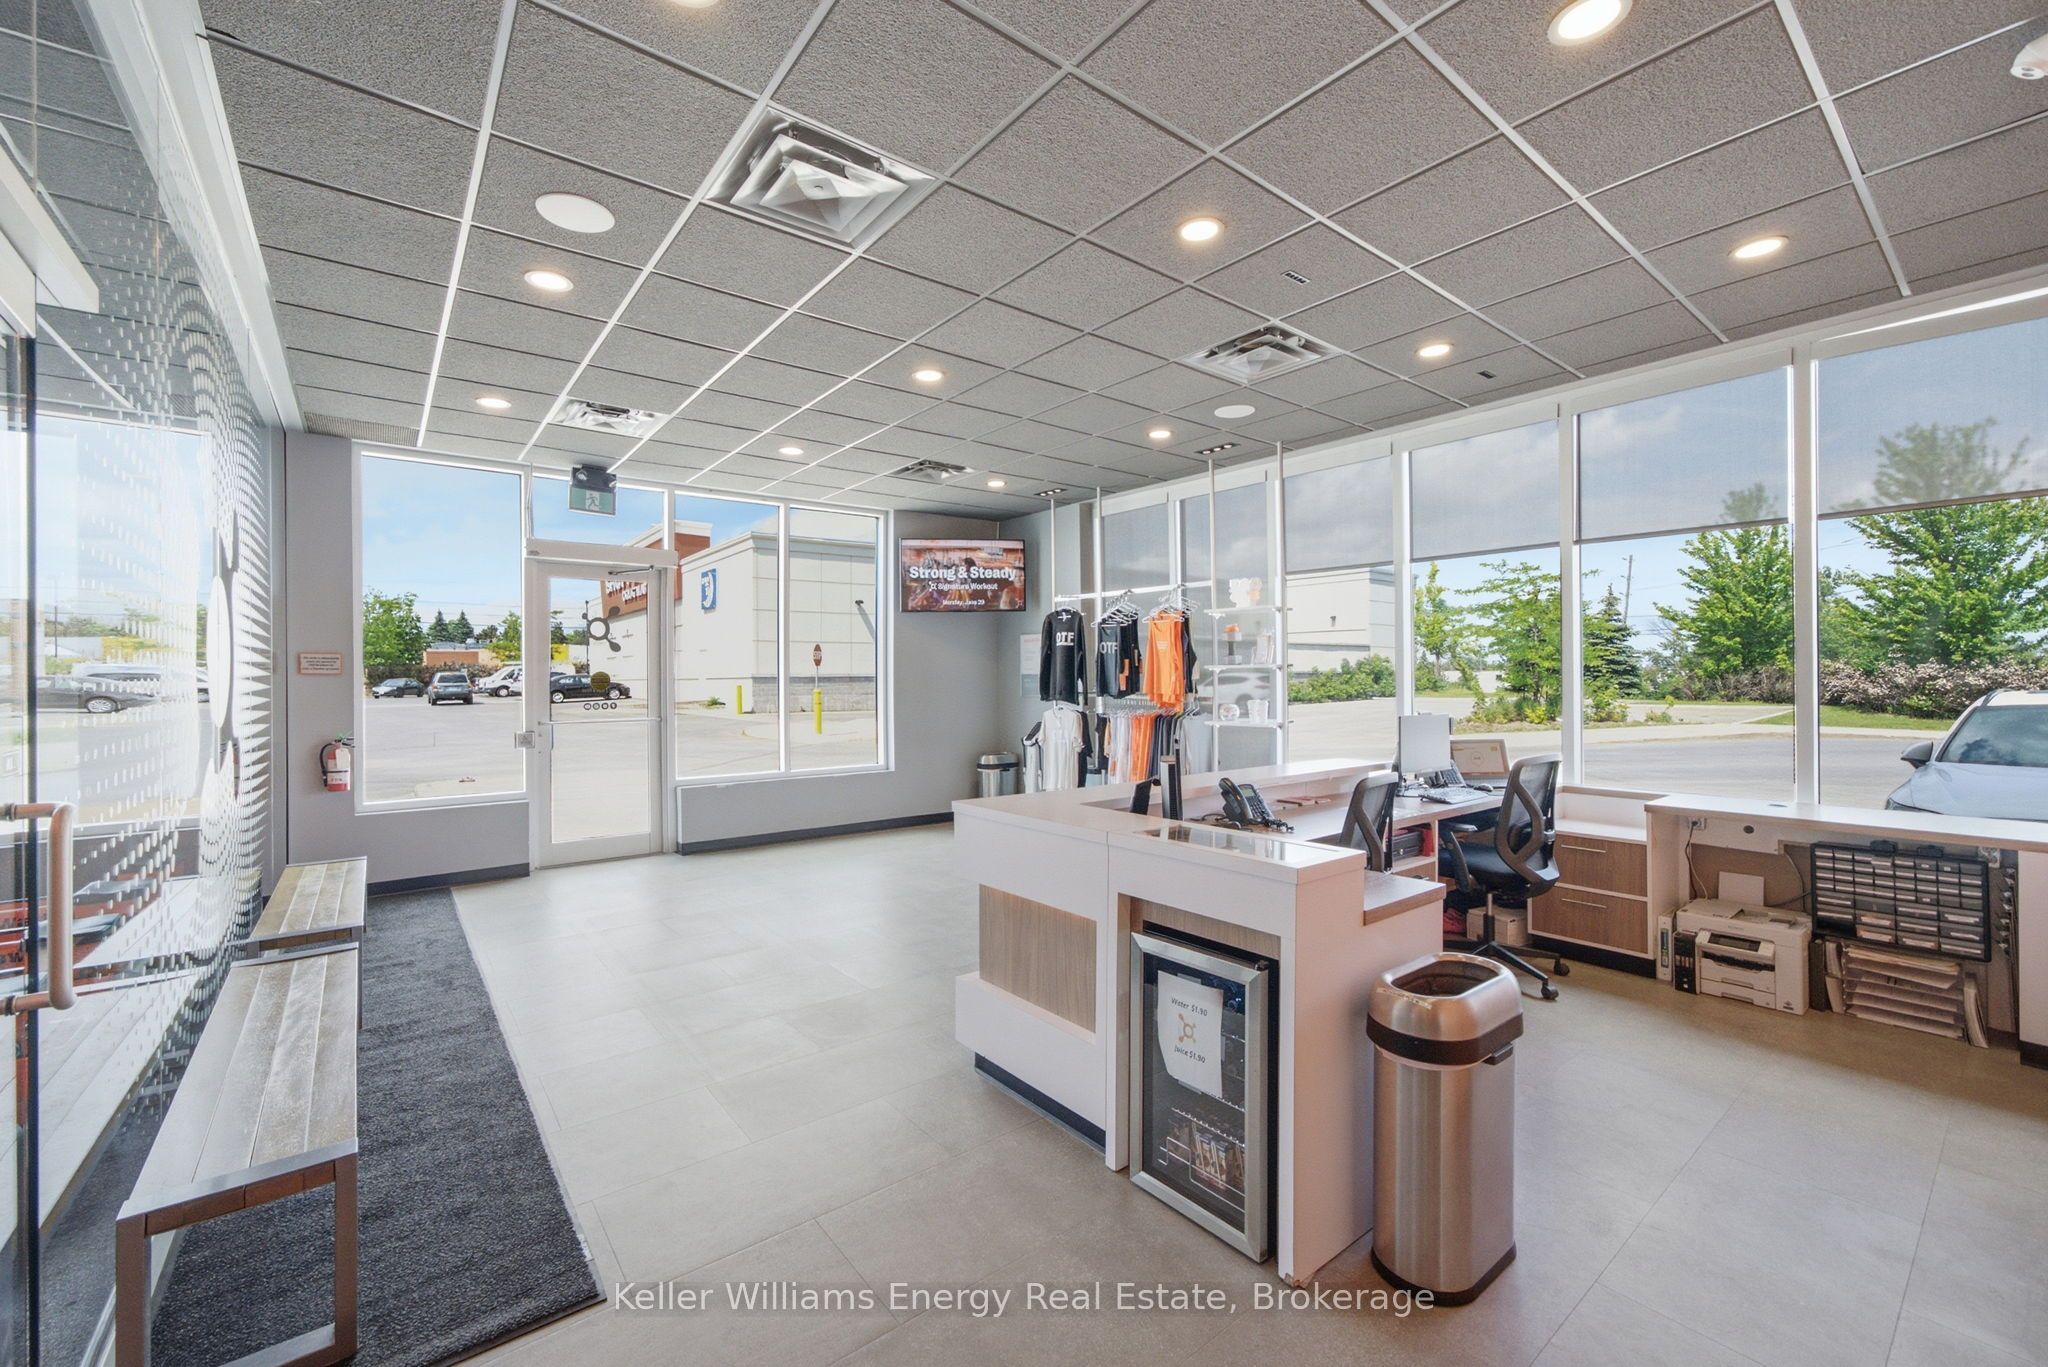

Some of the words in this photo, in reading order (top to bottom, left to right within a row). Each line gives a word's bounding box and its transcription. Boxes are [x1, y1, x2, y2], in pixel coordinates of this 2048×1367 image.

[909, 566, 956, 580] Strong
[958, 567, 968, 579] &
[970, 566, 1016, 581] Steady
[970, 582, 998, 590] Workout
[1055, 631, 1075, 644] OTF
[1099, 641, 1119, 654] OTF
[1171, 997, 1189, 1009] Water
[1191, 1004, 1208, 1016] $1.90
[1174, 1044, 1189, 1056] Juice
